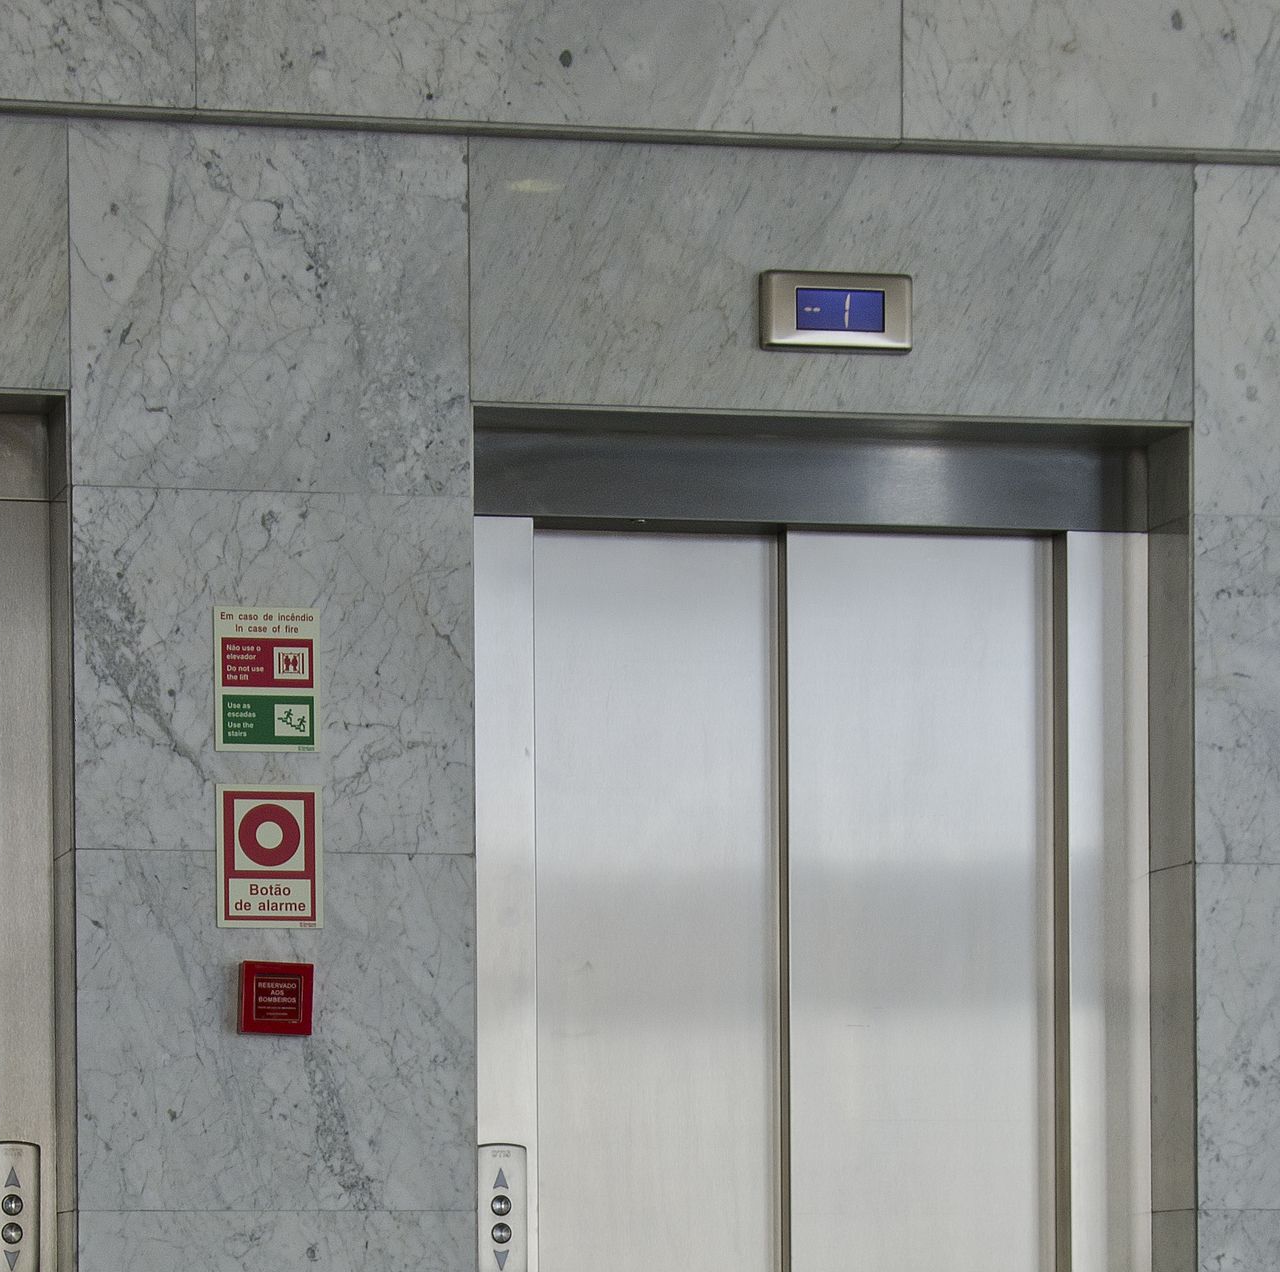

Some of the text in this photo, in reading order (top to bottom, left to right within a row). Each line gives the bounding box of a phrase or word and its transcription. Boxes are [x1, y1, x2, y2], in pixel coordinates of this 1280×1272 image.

[220, 612, 234, 621] Em
[263, 613, 273, 622] de
[277, 613, 314, 622] incêndio
[235, 624, 244, 633] In
[272, 625, 281, 633] of
[285, 625, 299, 634] fire
[226, 653, 257, 661] elevador
[227, 710, 256, 718] escadas
[227, 721, 241, 729] Use
[249, 883, 291, 896] Botão
[235, 899, 306, 912] de alarme
